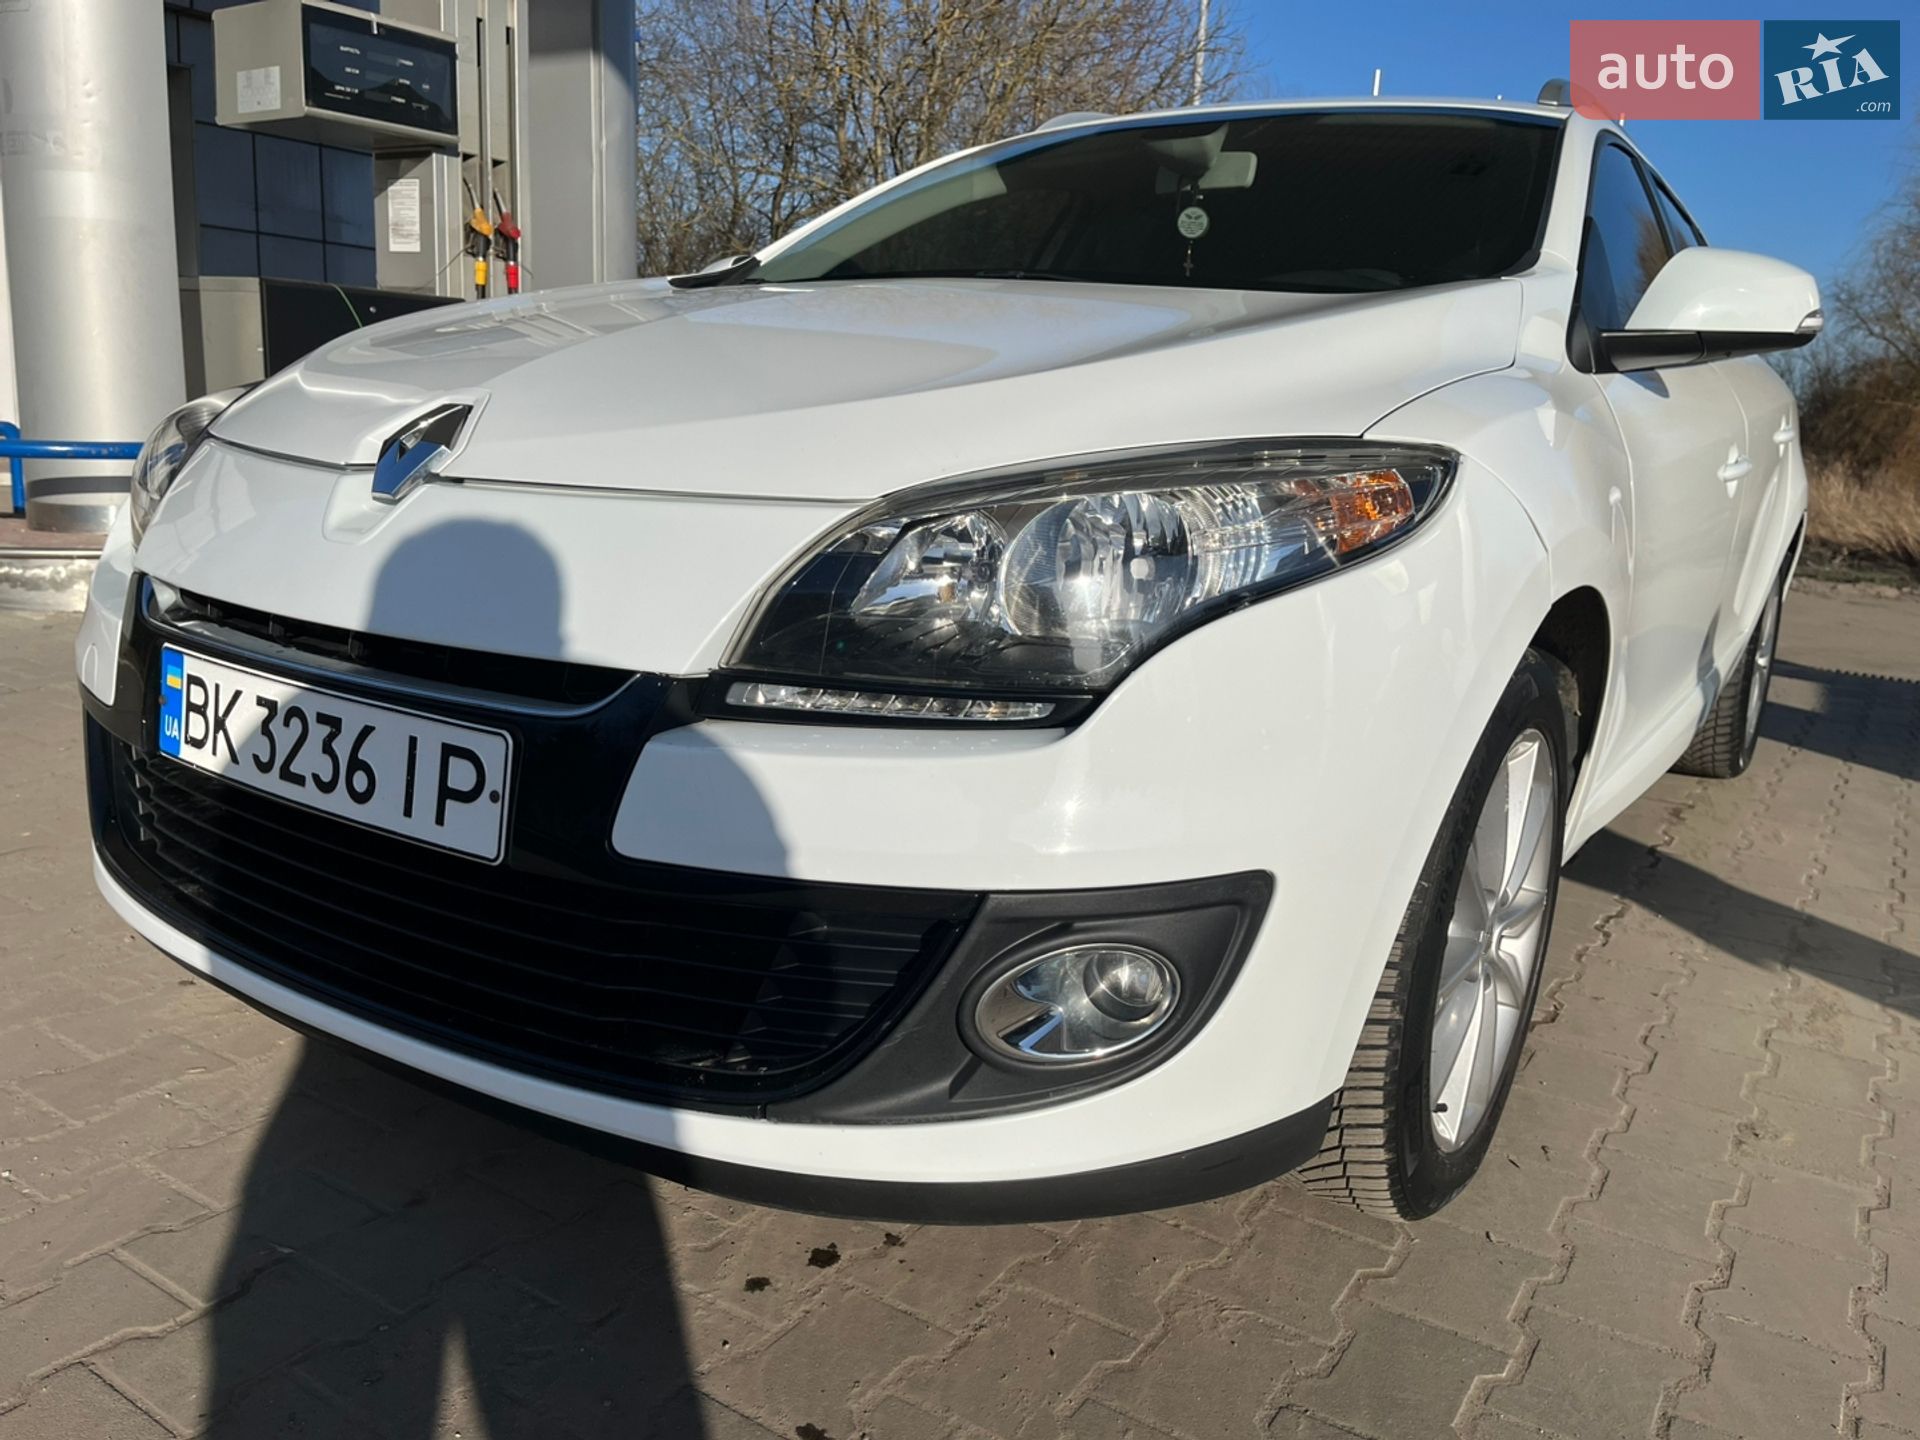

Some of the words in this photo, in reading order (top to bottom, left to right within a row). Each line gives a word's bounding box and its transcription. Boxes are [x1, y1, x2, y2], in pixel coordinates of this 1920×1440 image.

[164, 715, 180, 739] UA
[185, 673, 242, 765] BK
[252, 696, 377, 805] 3236
[403, 735, 487, 827] IP
